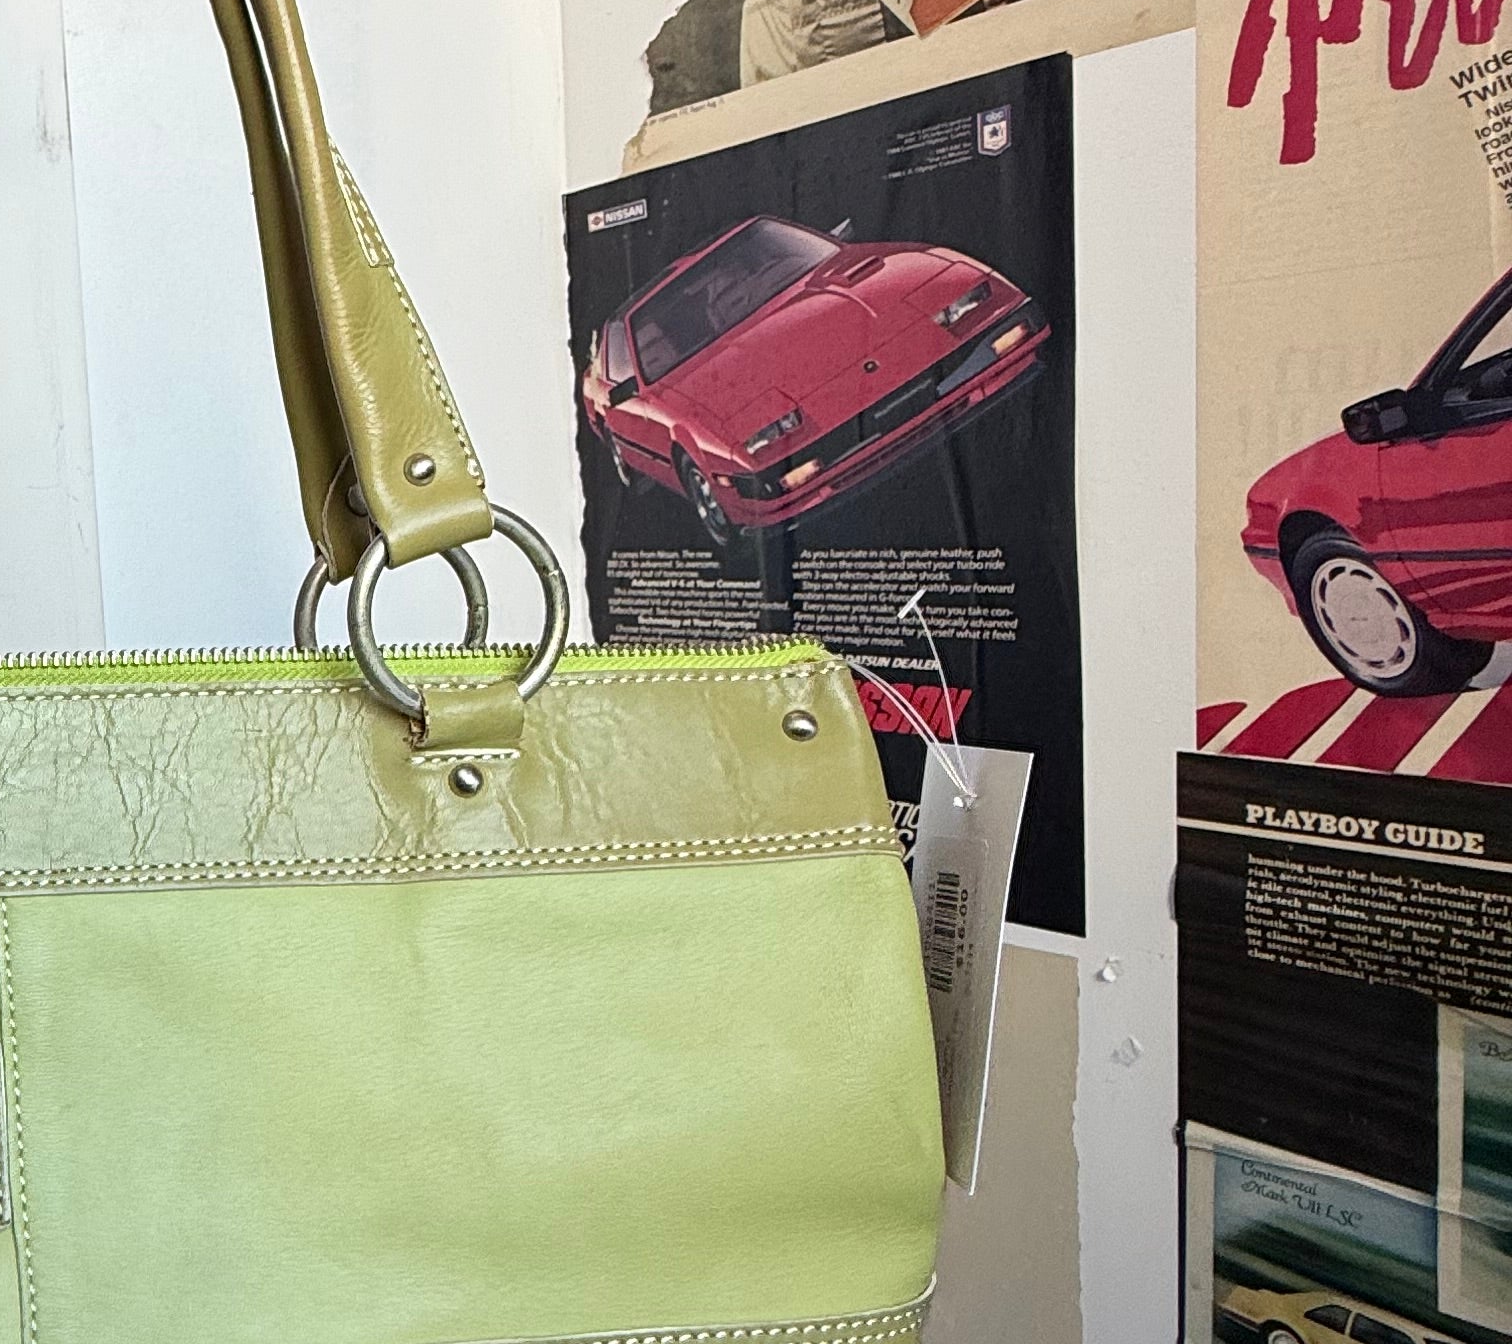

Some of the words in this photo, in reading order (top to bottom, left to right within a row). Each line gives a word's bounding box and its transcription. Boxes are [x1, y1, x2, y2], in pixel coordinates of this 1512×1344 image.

[605, 204, 643, 223] NISSAN
[900, 550, 938, 562] genuine
[977, 548, 1002, 563] push
[950, 584, 971, 595] your
[973, 583, 1015, 594] forward
[956, 630, 981, 639] what
[983, 630, 990, 640] it
[992, 630, 1016, 641] feels
[1245, 804, 1380, 841] PLAYBOY
[1384, 822, 1486, 855] GUIDE
[1307, 861, 1343, 878] under
[1347, 868, 1368, 881] the
